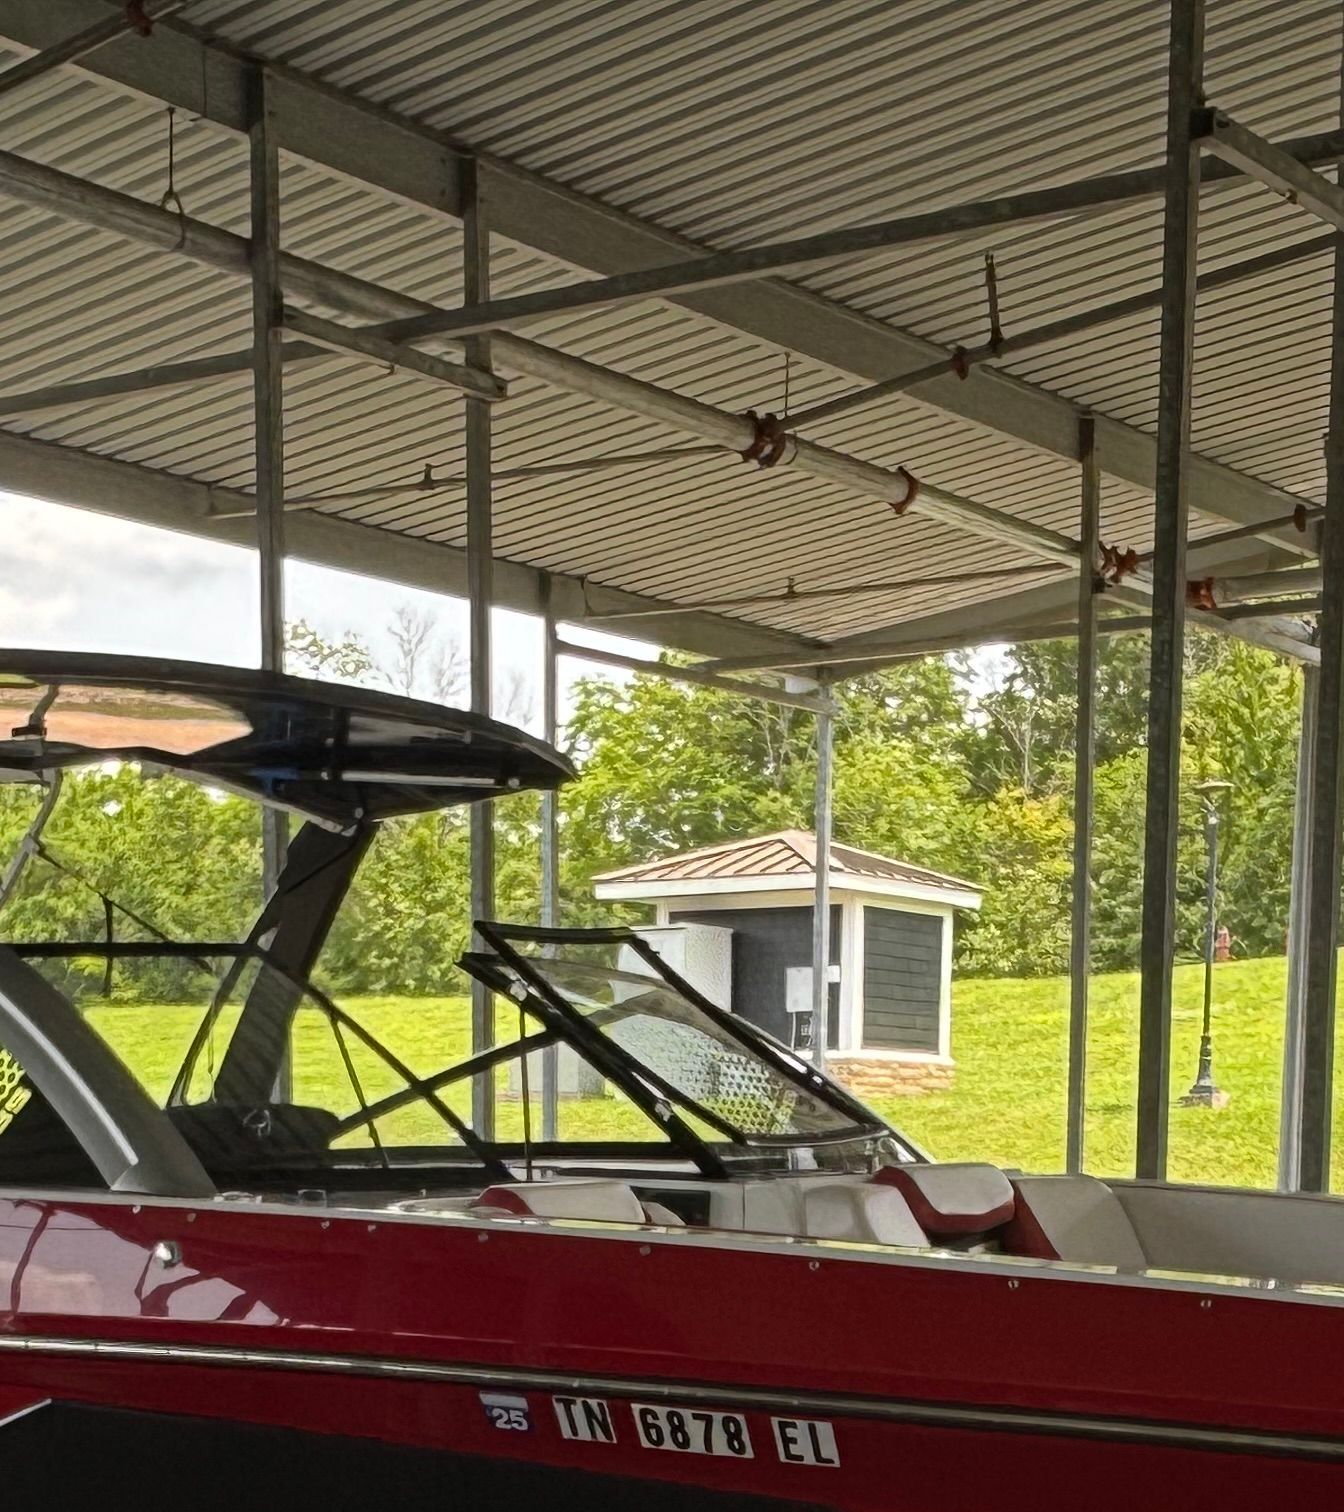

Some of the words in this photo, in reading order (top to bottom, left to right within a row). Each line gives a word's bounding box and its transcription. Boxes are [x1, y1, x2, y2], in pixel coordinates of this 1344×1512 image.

[492, 1408, 528, 1431] 25
[554, 1397, 613, 1441] TN
[639, 1407, 746, 1456] 6878
[778, 1420, 835, 1464] EL
